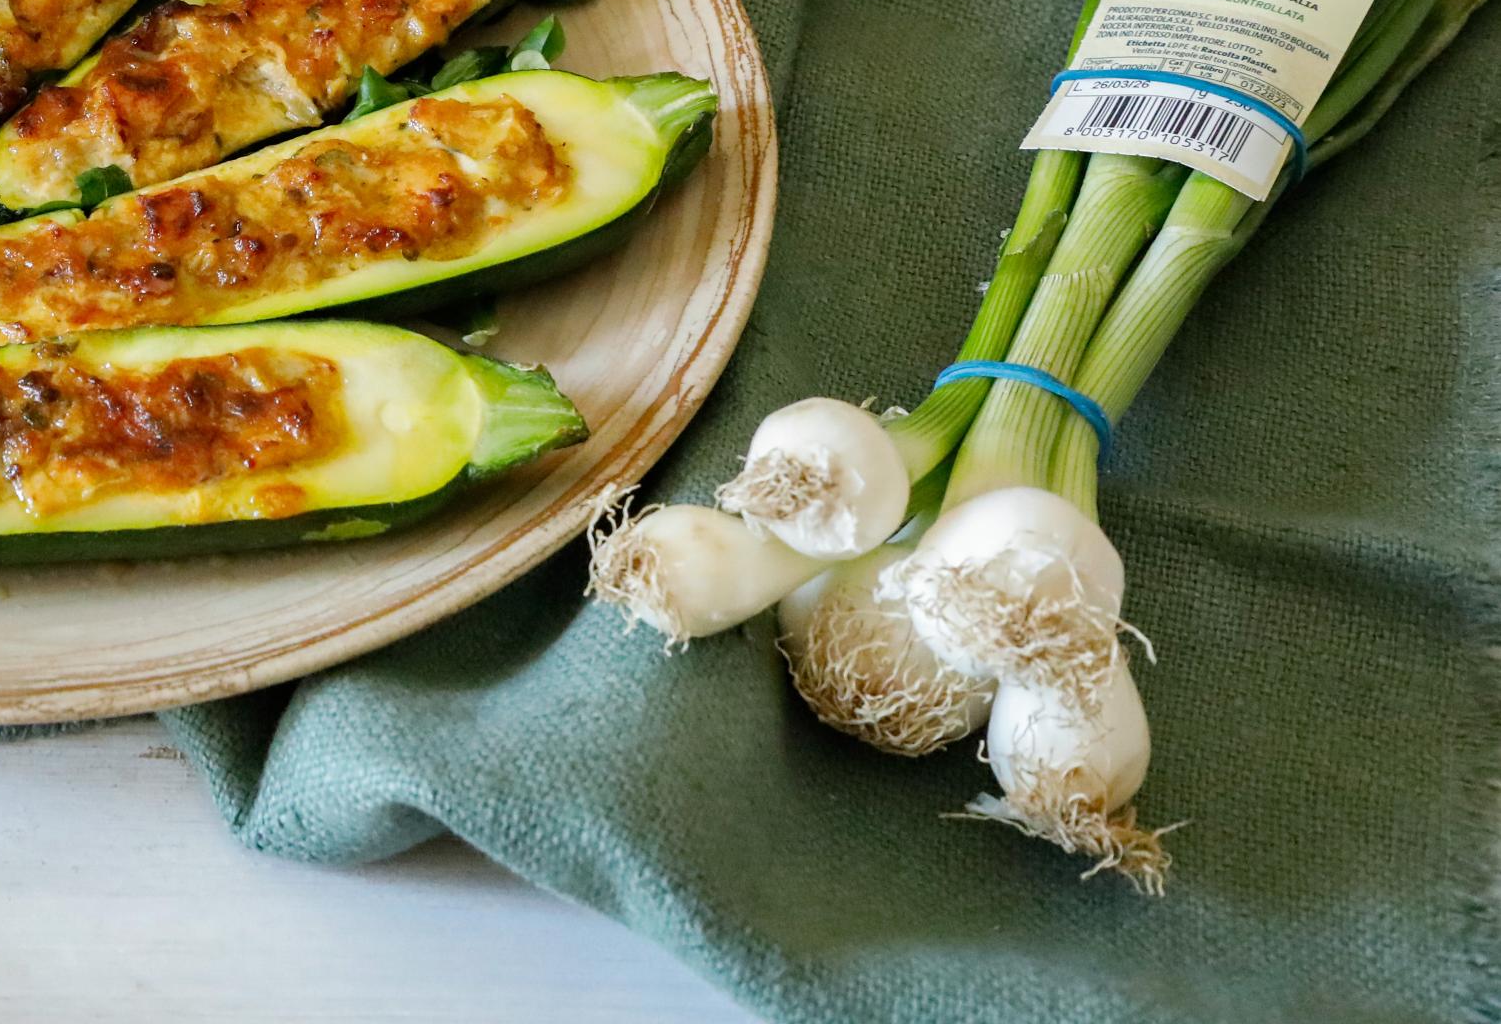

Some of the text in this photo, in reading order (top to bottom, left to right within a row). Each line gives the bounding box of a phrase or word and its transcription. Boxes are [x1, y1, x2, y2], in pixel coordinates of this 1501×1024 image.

[1107, 6, 1152, 14] PRODOTTO
[1152, 7, 1167, 15] PER
[1167, 8, 1198, 18] CONAD
[1214, 15, 1228, 23] VIA
[1279, 31, 1291, 40] 59
[1290, 36, 1330, 61] BOLOGNA
[1132, 23, 1174, 31] INFERIORE
[1196, 20, 1224, 30] NELLO
[1224, 24, 1285, 48] STABILIMENTO
[1285, 44, 1296, 53] DI
[1228, 41, 1257, 54] LOTTO
[1126, 39, 1166, 47] Etichetta
[1200, 46, 1240, 60] Raccolta
[1241, 55, 1278, 74] Plastica
[1171, 50, 1199, 59] regole
[1213, 57, 1227, 65] tuo
[1194, 64, 1224, 74] Calibro
[1091, 80, 1151, 89] 26/03/26
[1081, 127, 1229, 161] 003170 105317
